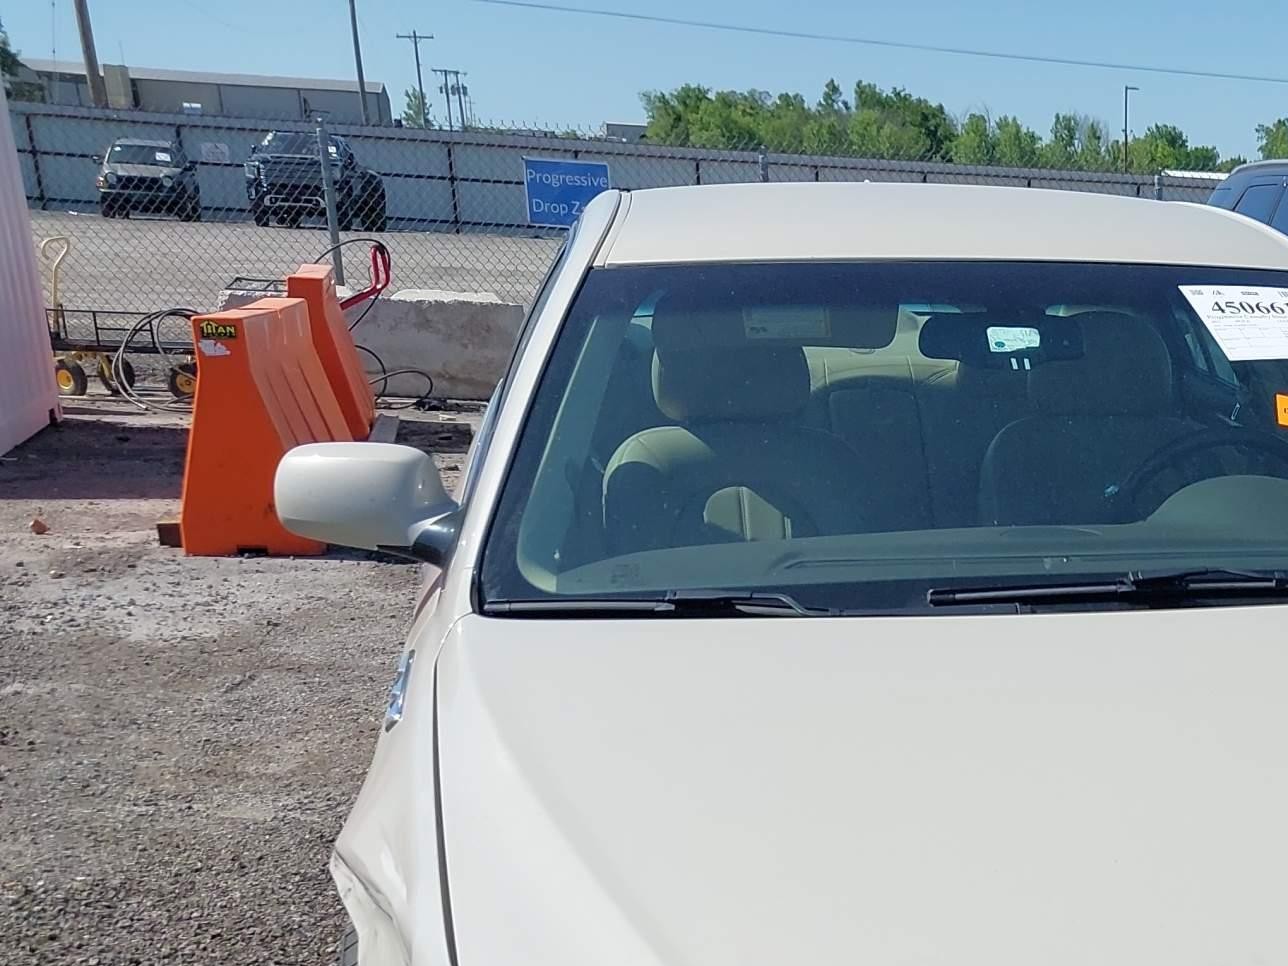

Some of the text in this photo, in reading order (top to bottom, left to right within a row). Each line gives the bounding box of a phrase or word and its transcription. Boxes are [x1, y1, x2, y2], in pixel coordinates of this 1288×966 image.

[527, 169, 608, 187] Progressive
[533, 199, 568, 216] Drop
[200, 321, 236, 337] TITAN
